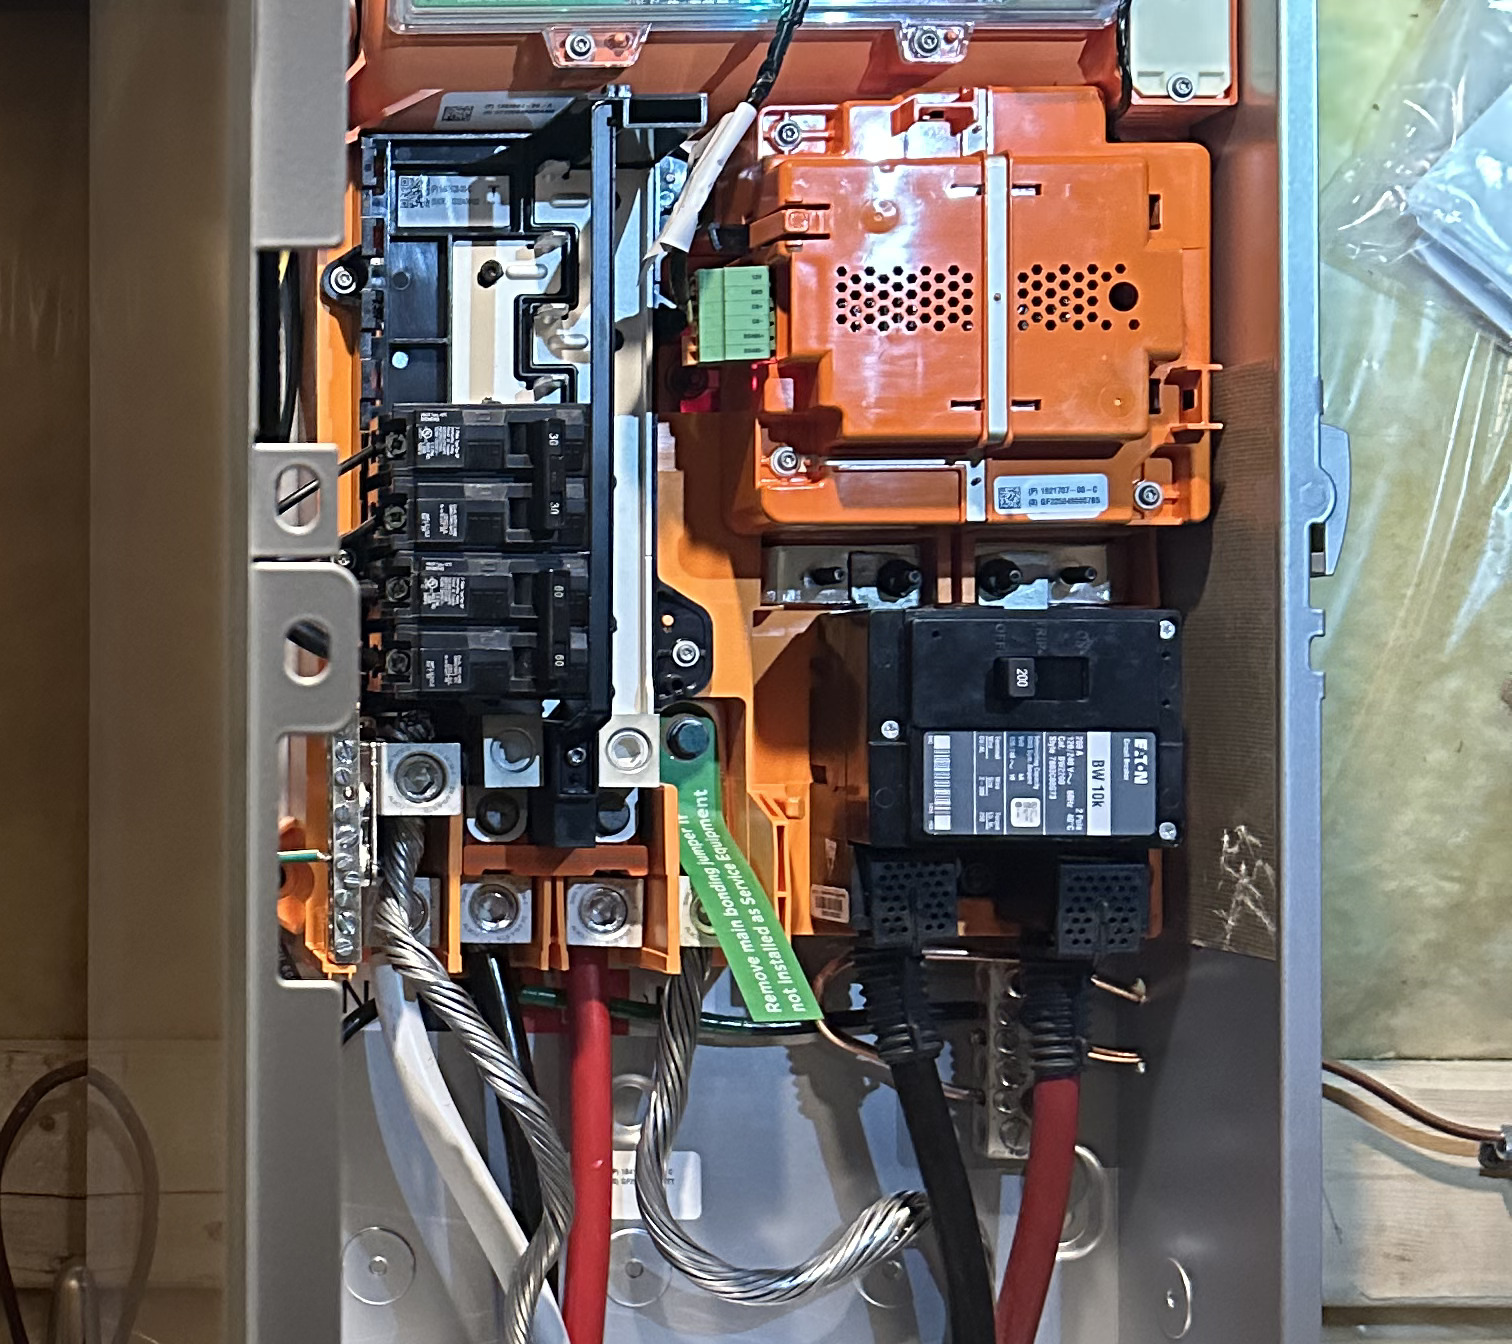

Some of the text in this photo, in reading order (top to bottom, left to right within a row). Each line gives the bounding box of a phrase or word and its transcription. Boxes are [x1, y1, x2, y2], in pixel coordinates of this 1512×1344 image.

[1016, 668, 1028, 688] 200
[1092, 760, 1106, 808] BW 10k
[693, 788, 732, 864] Equipment
[686, 827, 716, 869] jumper
[706, 864, 739, 918] bonding
[727, 862, 758, 906] Service
[731, 916, 756, 953] main
[751, 907, 765, 925] as
[747, 956, 782, 1014] Remove
[780, 986, 807, 1013] not
